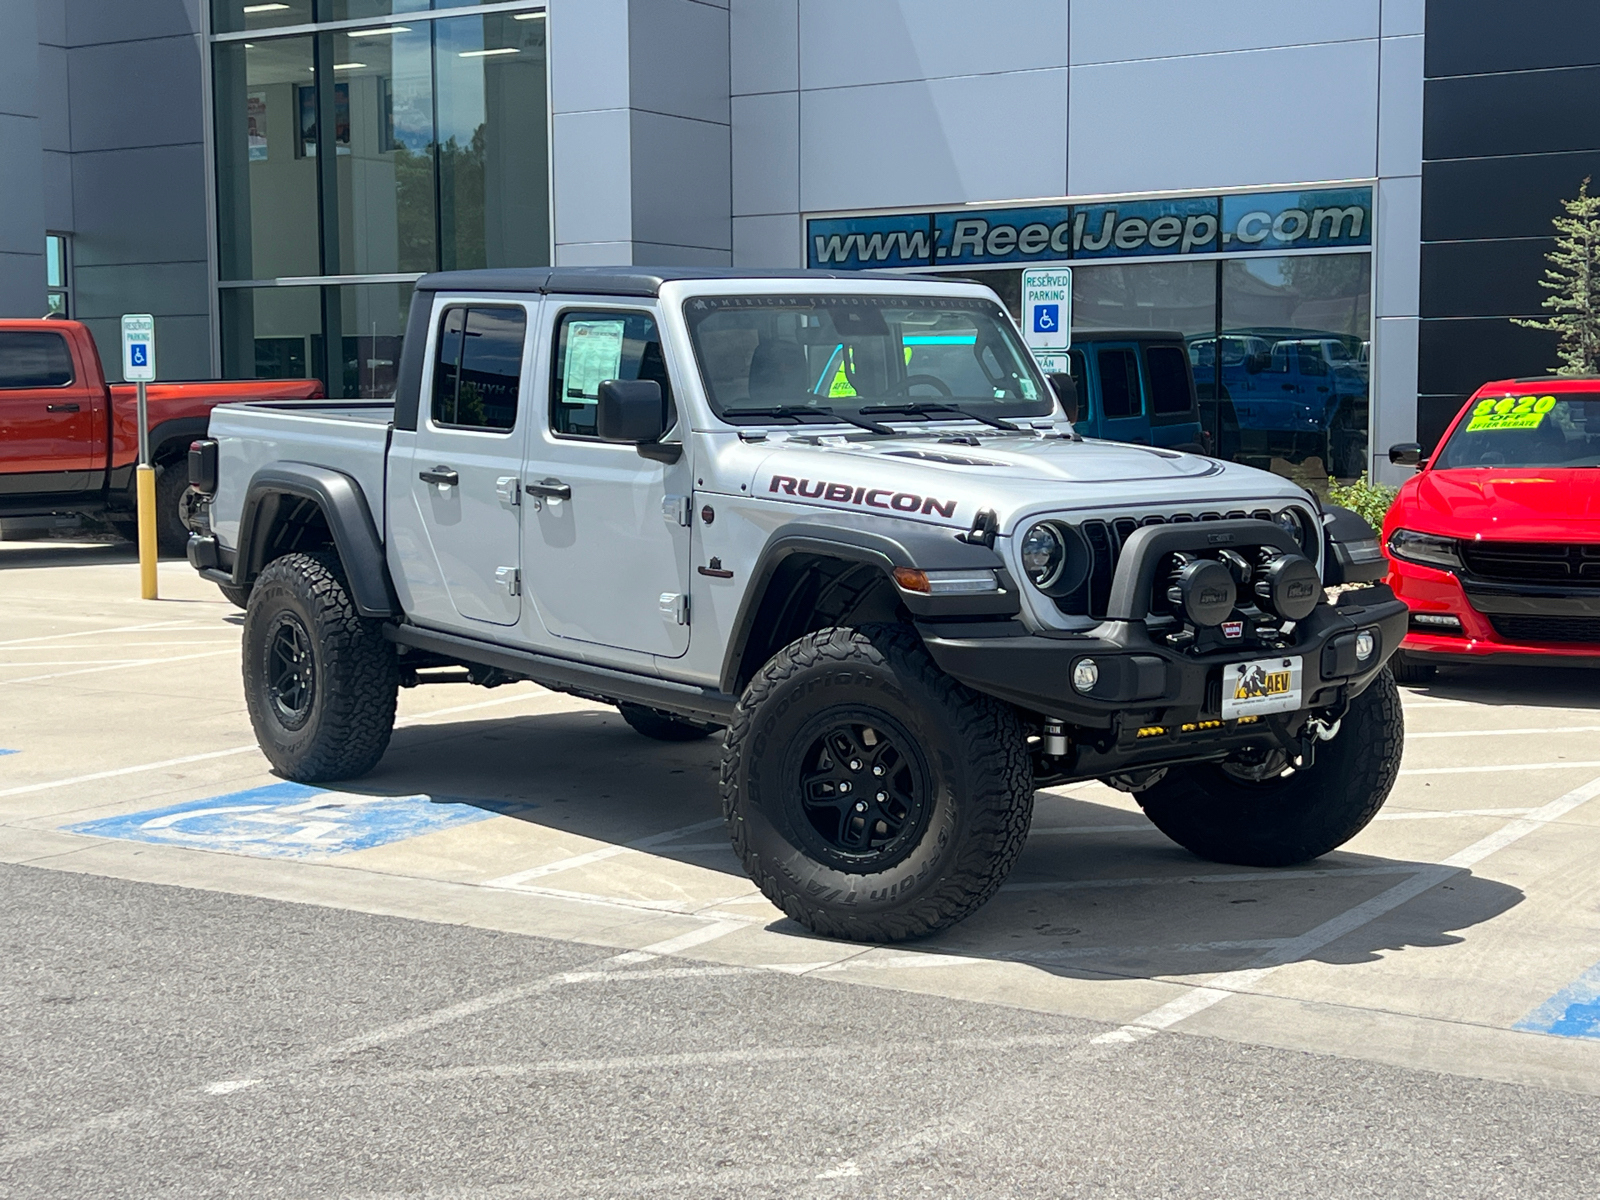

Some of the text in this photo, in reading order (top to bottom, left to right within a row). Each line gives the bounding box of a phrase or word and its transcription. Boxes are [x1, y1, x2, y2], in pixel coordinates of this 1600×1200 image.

[814, 205, 1365, 264] www.ReedJeep.com
[1026, 275, 1068, 288] RESERVED
[1028, 290, 1065, 301] PARKING
[710, 297, 993, 309] AMERICAN EXPEDITION VEHICLES
[126, 332, 150, 341] PARKING
[1473, 396, 1556, 416] 8420
[1489, 413, 1526, 421] OFF
[1470, 420, 1536, 430] AFTER REBATE
[768, 475, 958, 519] RUBICON
[1266, 672, 1289, 693] AEV
